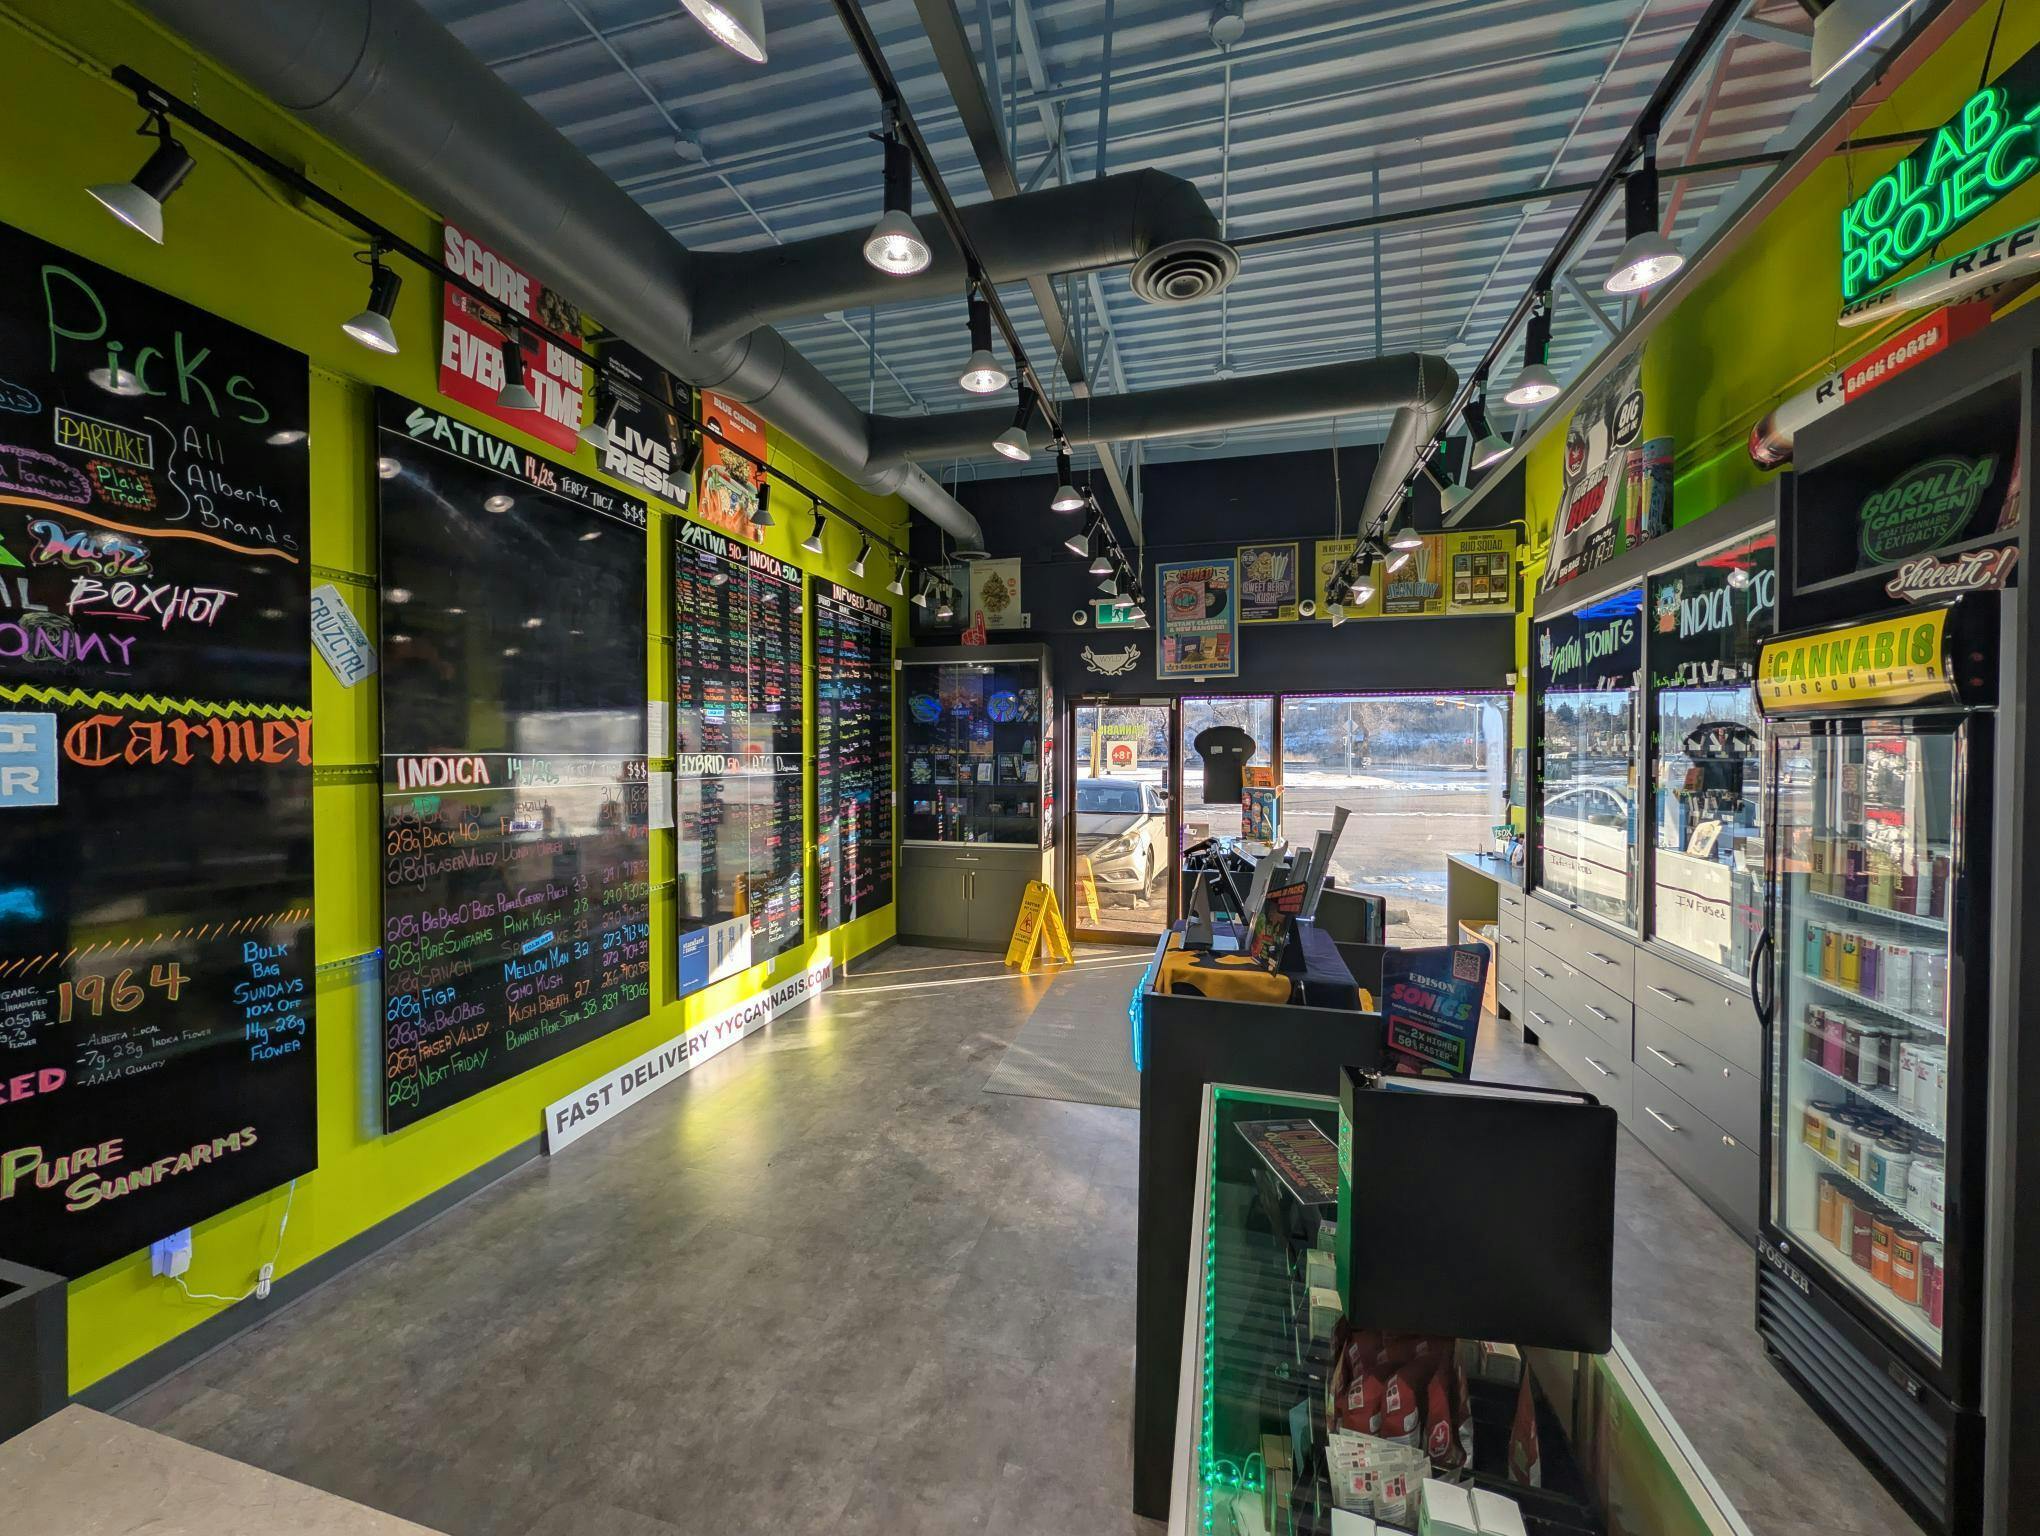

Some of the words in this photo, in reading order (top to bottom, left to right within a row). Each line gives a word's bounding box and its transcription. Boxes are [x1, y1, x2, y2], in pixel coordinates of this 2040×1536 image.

[1842, 87, 2003, 251] KOLAB
[444, 225, 531, 321] SCORE
[546, 342, 584, 391] BIG
[531, 370, 584, 432] TIME
[1619, 395, 1640, 427] BIG
[60, 417, 149, 466] PARTAKE
[184, 425, 224, 465] All
[405, 407, 520, 475] SATIVA
[607, 418, 671, 473] LIVE
[96, 465, 145, 492] Plaid
[104, 485, 151, 505] Trout
[187, 464, 284, 513] Alberta
[1861, 458, 1993, 520] GORILLA
[194, 494, 299, 551] Brands
[1871, 492, 1968, 531] GARDEN
[681, 520, 727, 557] SATIVA
[1885, 523, 1948, 551] EXTRACTS
[749, 550, 782, 577] INDICA
[832, 584, 865, 609] INFUSED
[1243, 582, 1267, 594] SWEET
[1680, 585, 1734, 639] INDICA
[1551, 635, 1583, 684] SATIVA
[1585, 619, 1635, 665] JOINTS
[1773, 623, 1936, 685] CANNABIS
[1774, 667, 1937, 698] DISCOUNTER
[397, 757, 491, 791] INDICA
[679, 754, 725, 775] HYBRID
[422, 831, 458, 850] BACK
[459, 822, 480, 843] 40
[243, 941, 289, 964] BULK
[252, 963, 281, 979] BAG
[59, 962, 193, 1024] 1964
[233, 978, 304, 1004] SUNDAYS
[387, 995, 421, 1026] 28g
[503, 957, 548, 983] MELLOW
[549, 946, 570, 970] MAN
[1391, 983, 1473, 1021] SONICS
[1408, 972, 1457, 994] EDISON
[246, 1003, 274, 1018] 10%
[277, 998, 302, 1012] OFF
[113, 1041, 144, 1059] 28g
[250, 1040, 302, 1061] FLOWER
[450, 1047, 489, 1076] FRIDAY
[556, 1083, 614, 1134] FAST
[620, 1030, 710, 1097] DELIVERY
[714, 965, 832, 1040] YYCCANNABIS.COM
[1, 1138, 124, 1200] PURE
[66, 1126, 258, 1212] SUNFARMS
[1759, 1240, 1810, 1295] FOSTER
